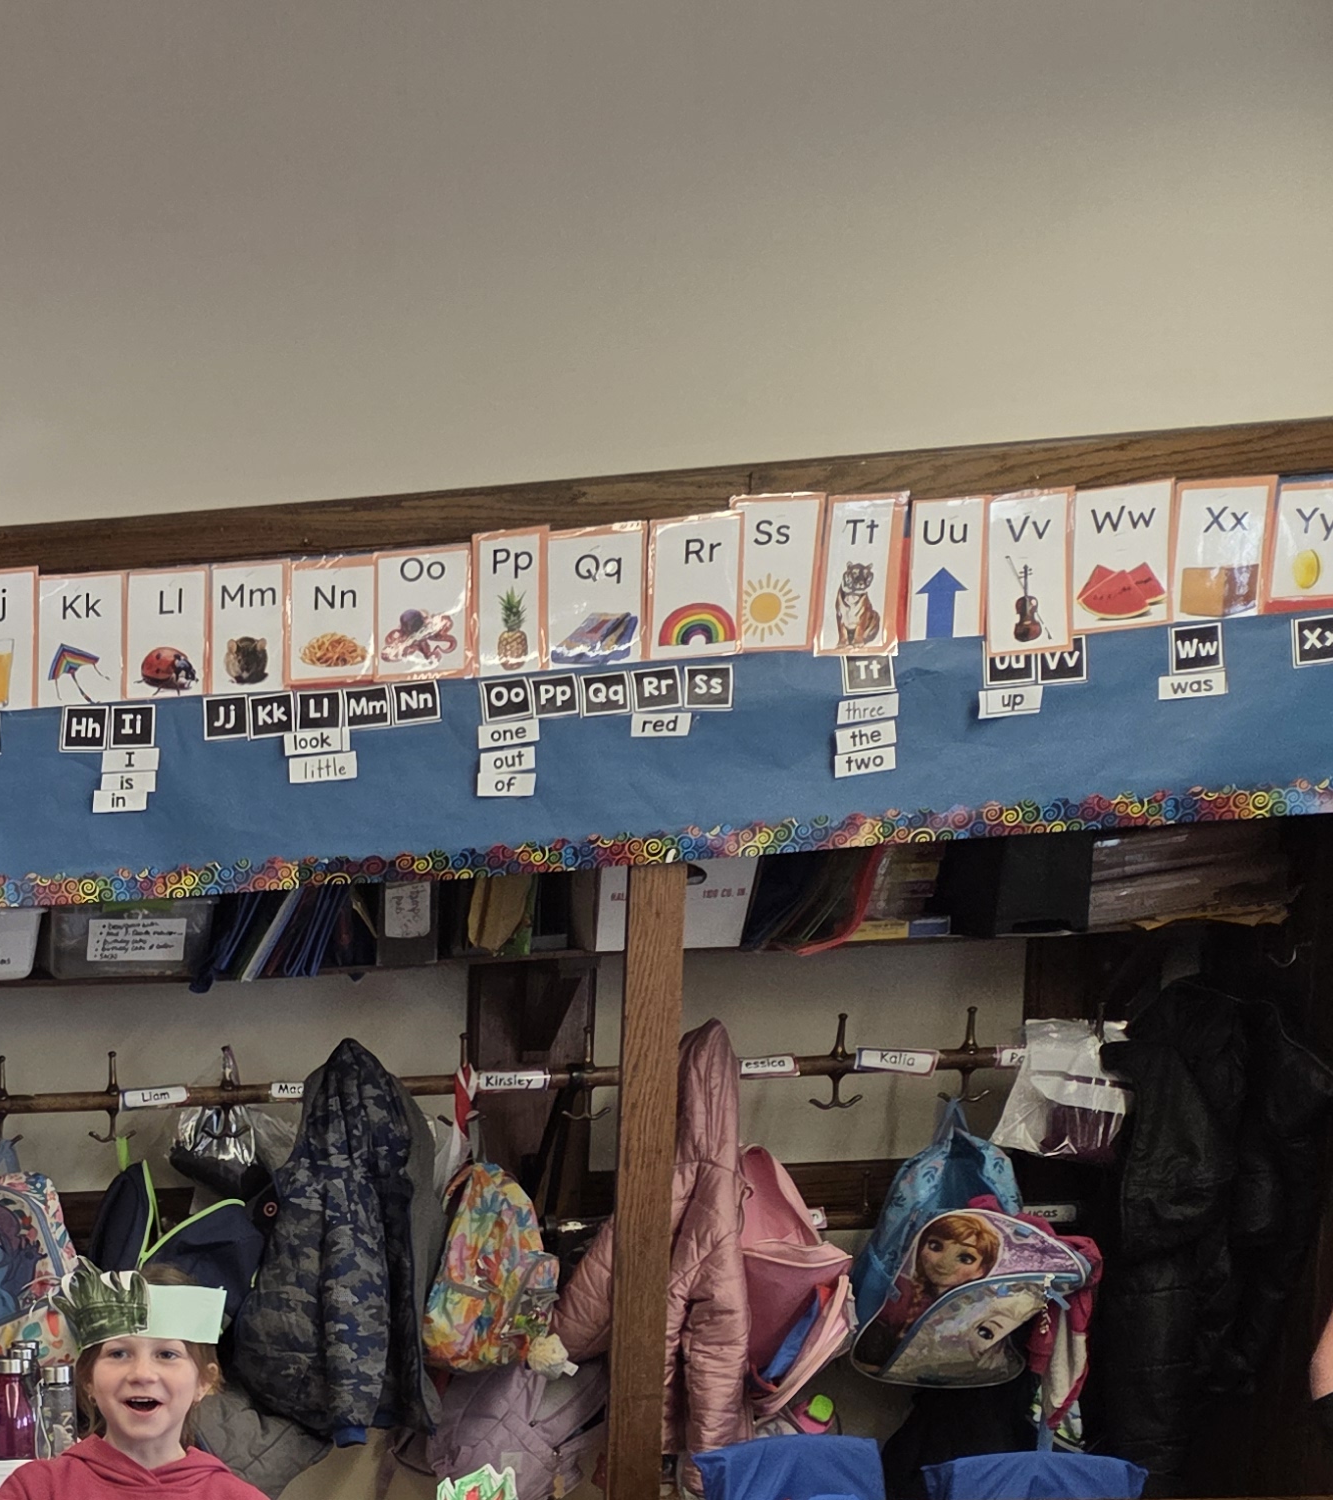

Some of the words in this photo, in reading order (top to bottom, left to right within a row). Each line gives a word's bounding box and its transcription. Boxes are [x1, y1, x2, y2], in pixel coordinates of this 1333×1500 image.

[1006, 516, 1051, 543] Vv
[1091, 505, 1156, 534] Ww
[1204, 506, 1249, 533] Xx
[754, 520, 790, 545] Ss
[846, 519, 879, 545] Tt
[923, 519, 968, 545] Uu
[685, 538, 721, 564] Rr
[400, 557, 446, 583] Oo
[492, 548, 533, 578] Pp
[575, 554, 622, 584] Qq
[62, 594, 101, 619] Kk
[220, 584, 277, 609] Mm
[314, 585, 357, 610] Nn
[1176, 638, 1217, 660] Ww
[856, 659, 881, 680] Tt
[643, 676, 674, 697] Rr
[694, 675, 722, 694] Ss
[1171, 678, 1213, 696] was
[400, 689, 433, 711] Nn
[490, 686, 524, 706] Oo
[540, 685, 571, 706] Pp
[588, 685, 624, 706] Qq
[1002, 692, 1024, 709] up
[214, 705, 235, 729] Jj
[257, 705, 287, 724] Kk
[349, 698, 387, 717] Mm
[845, 695, 885, 719] three
[71, 718, 100, 737] Hh
[121, 714, 142, 734] Ii
[491, 725, 527, 741] one
[641, 715, 678, 732] red
[294, 732, 331, 750] look
[850, 728, 881, 747] the
[125, 752, 134, 767] I
[494, 751, 524, 769] out
[846, 752, 884, 772] two
[304, 761, 345, 779] little
[120, 775, 133, 790] is
[495, 777, 515, 793] of
[111, 793, 126, 807] in
[744, 1057, 786, 1069] essica
[880, 1051, 915, 1067] Kalia
[485, 1073, 534, 1089] Kinsley
[141, 1090, 170, 1102] Liam
